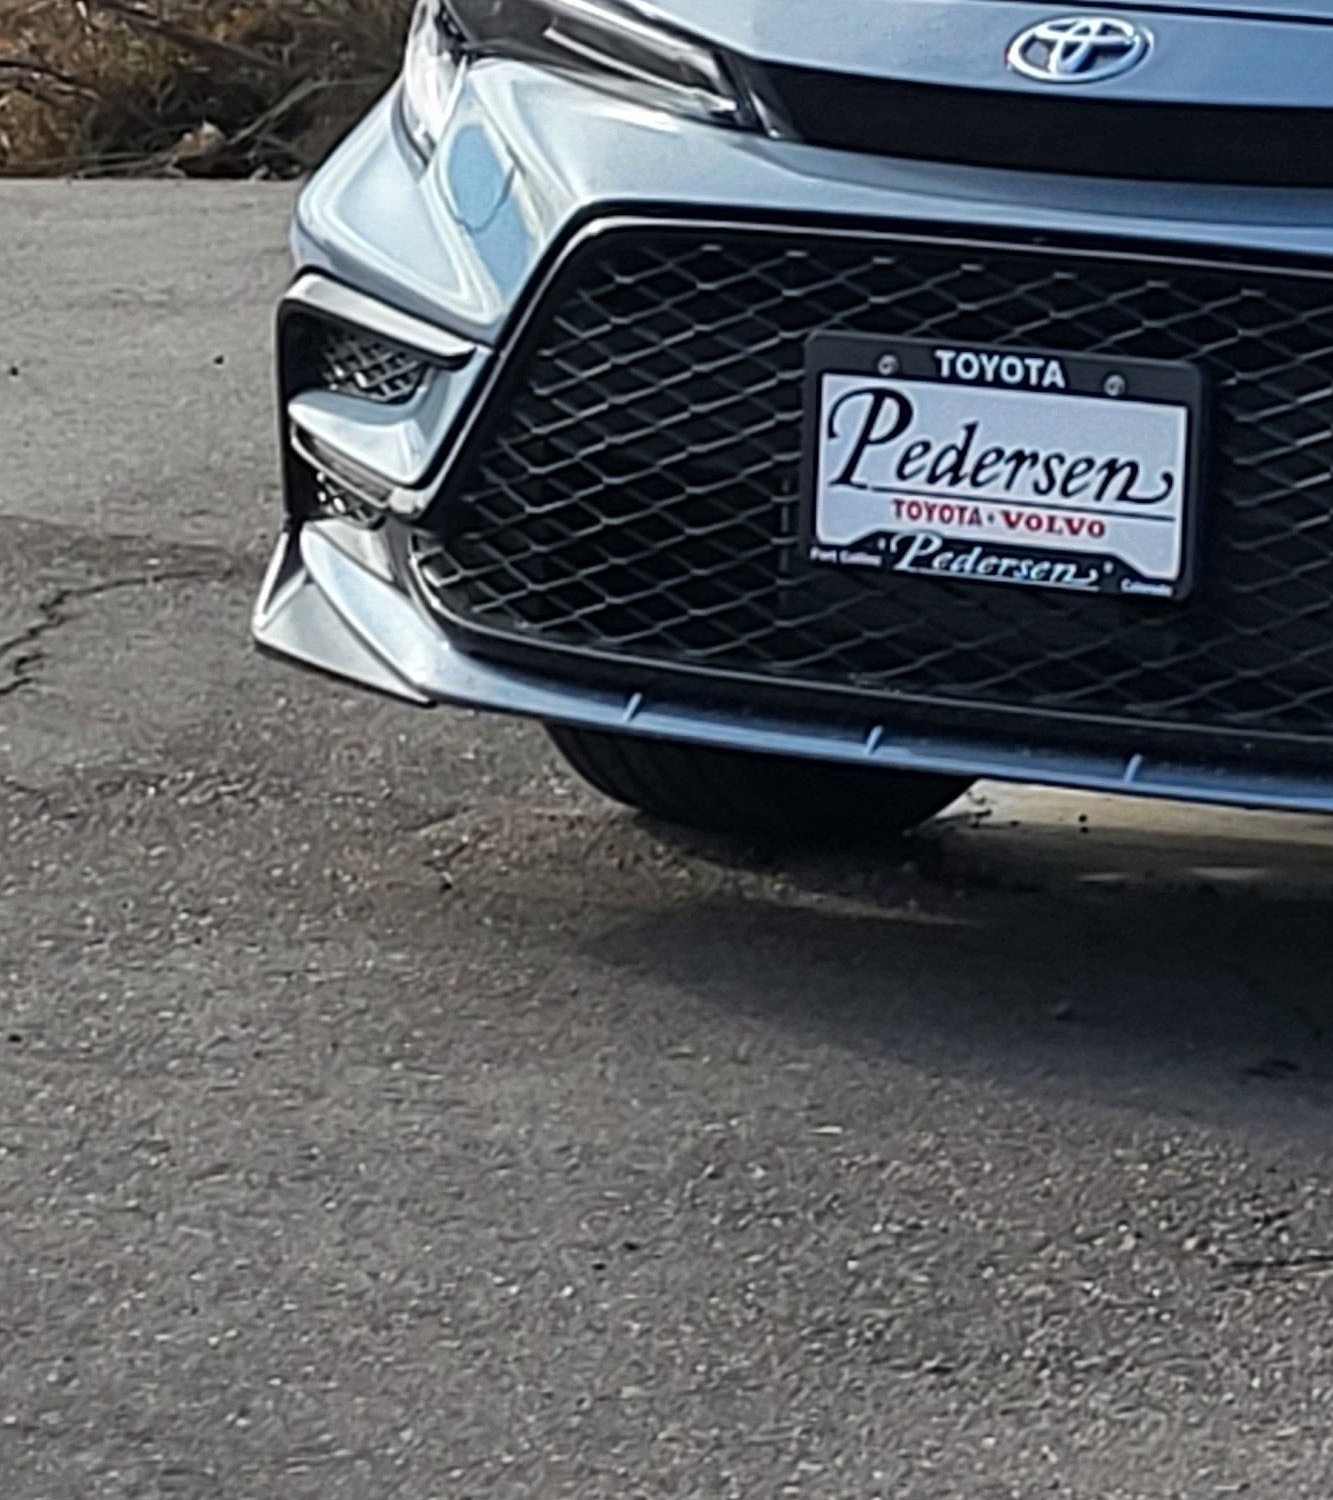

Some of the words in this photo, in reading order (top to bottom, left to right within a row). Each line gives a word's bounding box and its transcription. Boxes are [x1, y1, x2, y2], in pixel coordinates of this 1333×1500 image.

[934, 349, 1066, 388] TOYOTA
[827, 386, 1174, 506] Pedersen
[892, 498, 983, 527] TOYOTA
[1001, 509, 1106, 539] VOLVO
[889, 530, 1099, 588] Pedersen
